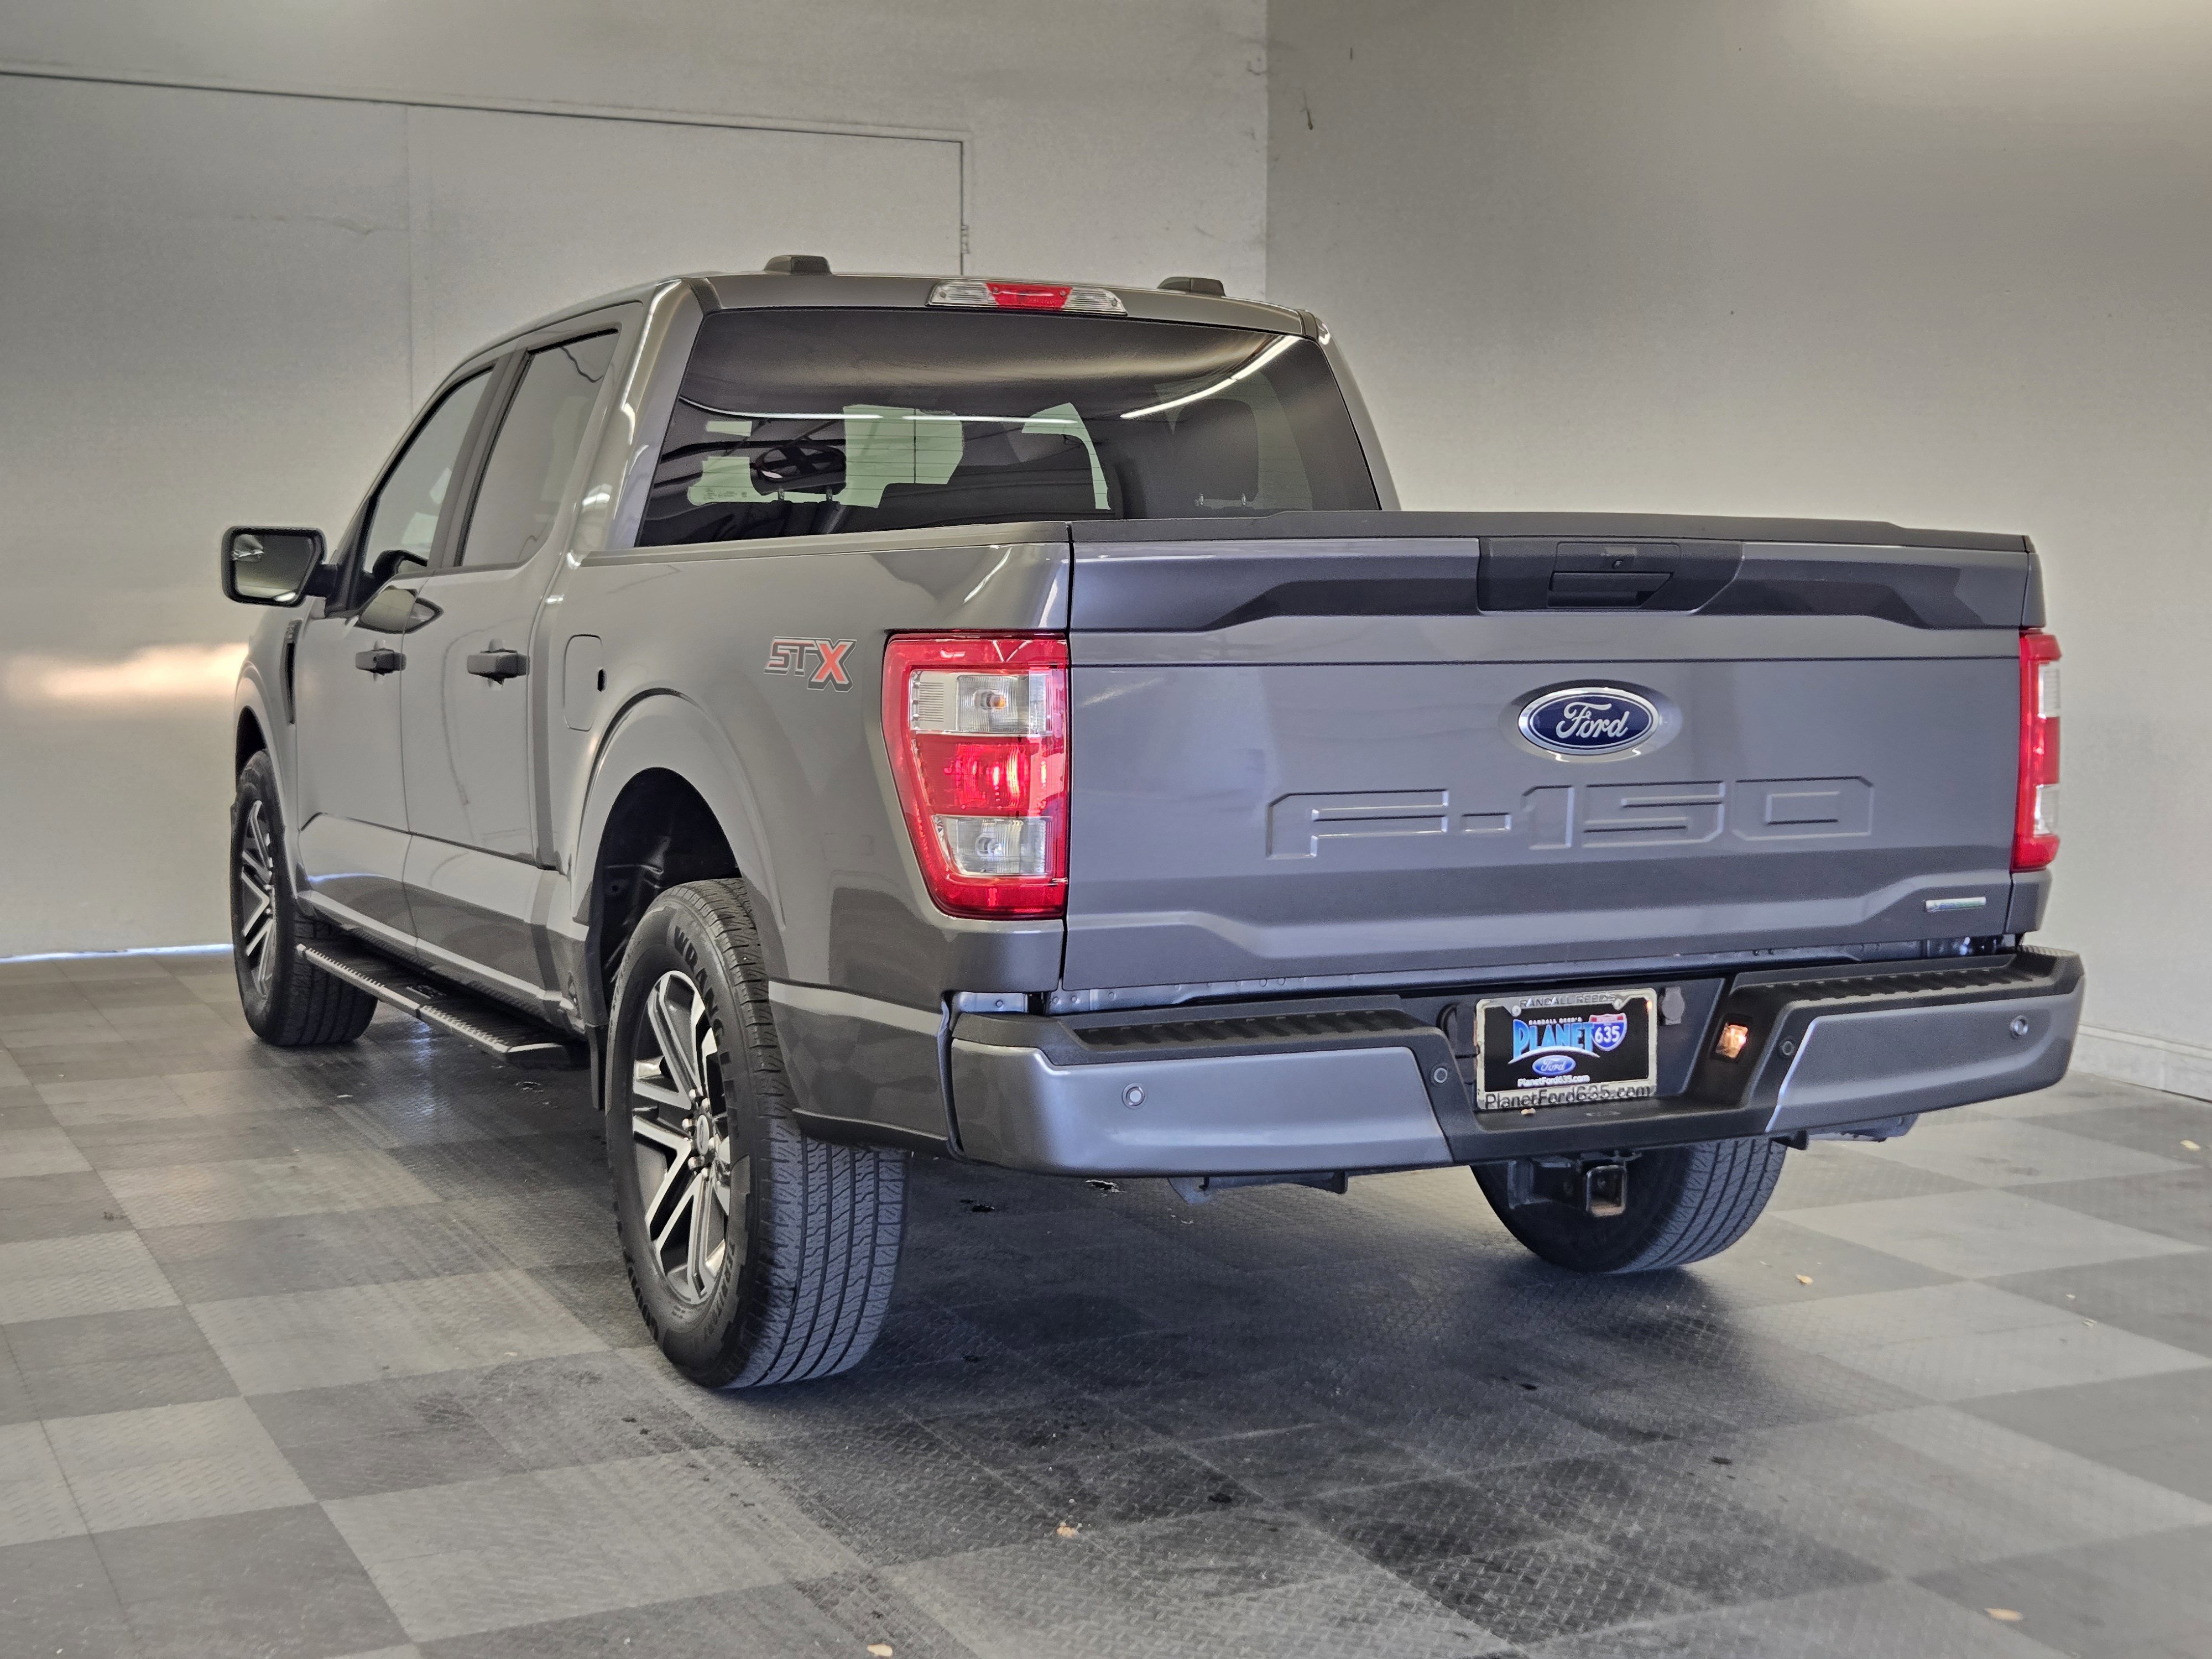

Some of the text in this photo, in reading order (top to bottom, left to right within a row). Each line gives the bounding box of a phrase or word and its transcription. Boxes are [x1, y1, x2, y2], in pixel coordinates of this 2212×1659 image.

[764, 636, 857, 692] STX
[1556, 702, 1630, 739] Ford
[1267, 775, 1875, 858] F-150
[1520, 995, 1573, 1008] RANDALL
[1513, 1019, 1620, 1059] PLANET 635
[1540, 1058, 1567, 1072] Ford
[1485, 1085, 1651, 1109] PlanetFord635.com
